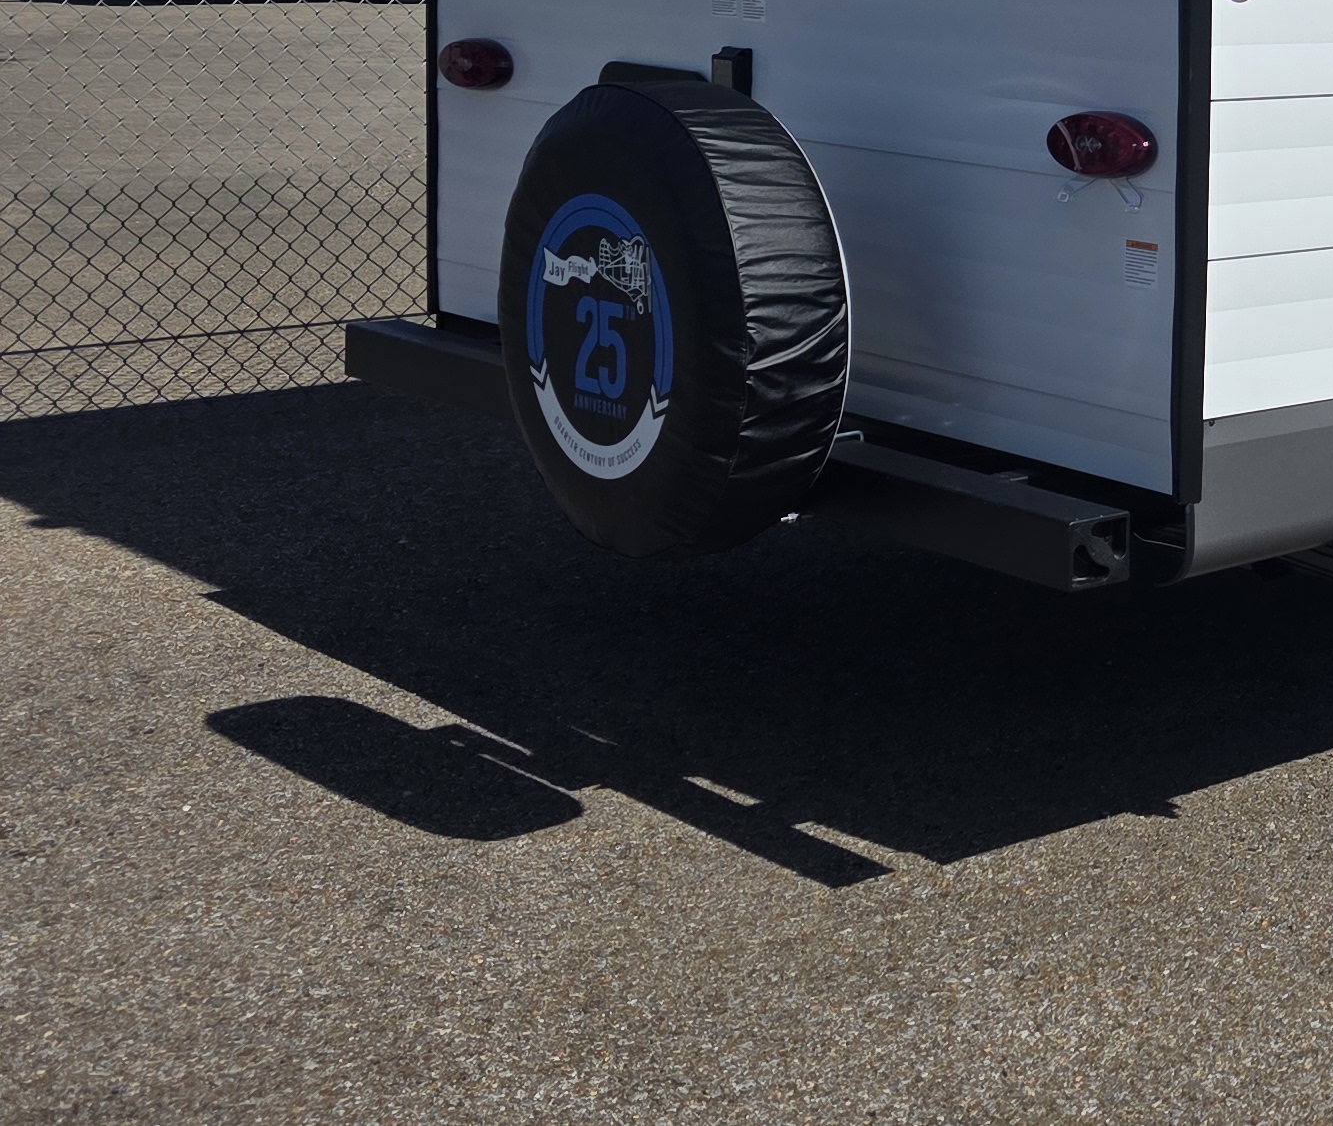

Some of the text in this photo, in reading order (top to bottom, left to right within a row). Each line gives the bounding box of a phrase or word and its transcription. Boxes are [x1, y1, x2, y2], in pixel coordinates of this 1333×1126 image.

[549, 260, 589, 282] Jay Flight
[573, 393, 628, 420] ANNIVERSARY
[554, 415, 643, 468] QUARTER CENTURY OF SUCCESS
